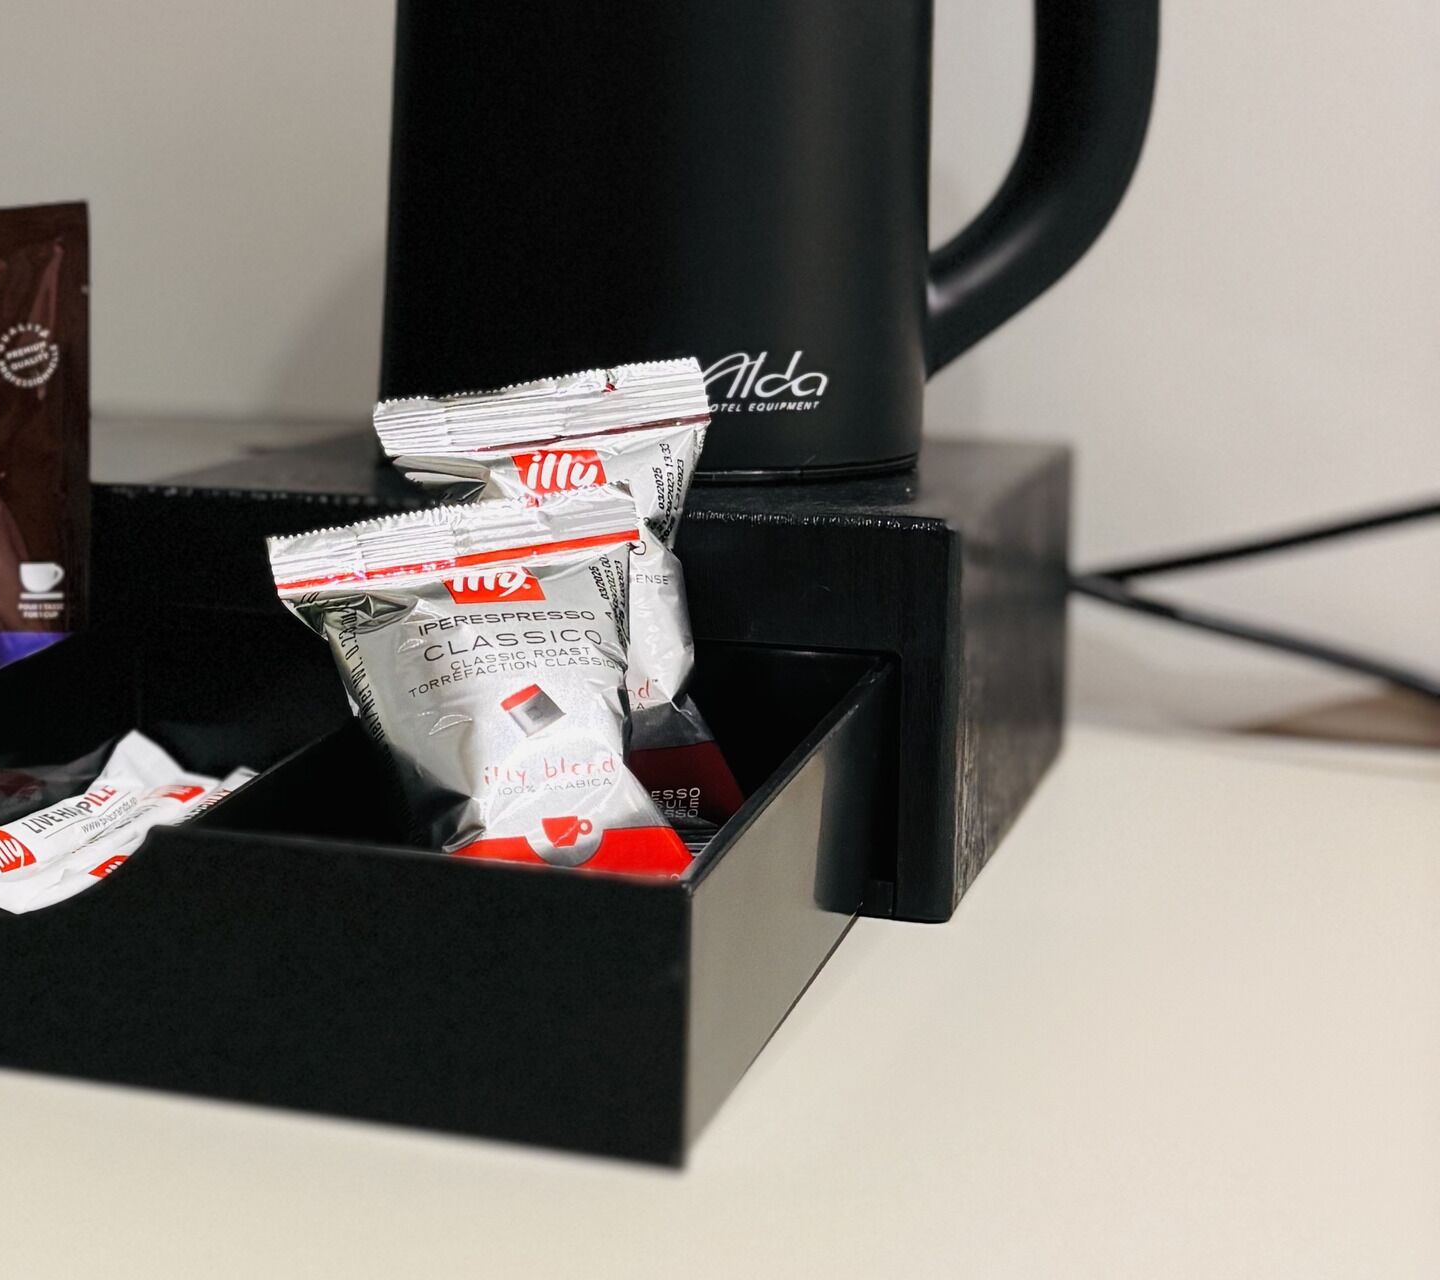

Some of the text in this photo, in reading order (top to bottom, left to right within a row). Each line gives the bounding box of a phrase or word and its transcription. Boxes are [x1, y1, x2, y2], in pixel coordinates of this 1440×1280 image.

[702, 350, 828, 399] Alda
[709, 400, 820, 413] OTEL EQUIPMENT
[418, 610, 596, 637] IPERESPRESSO
[423, 629, 602, 662] CLASSICO
[450, 646, 591, 671] CLASSIC ROAST
